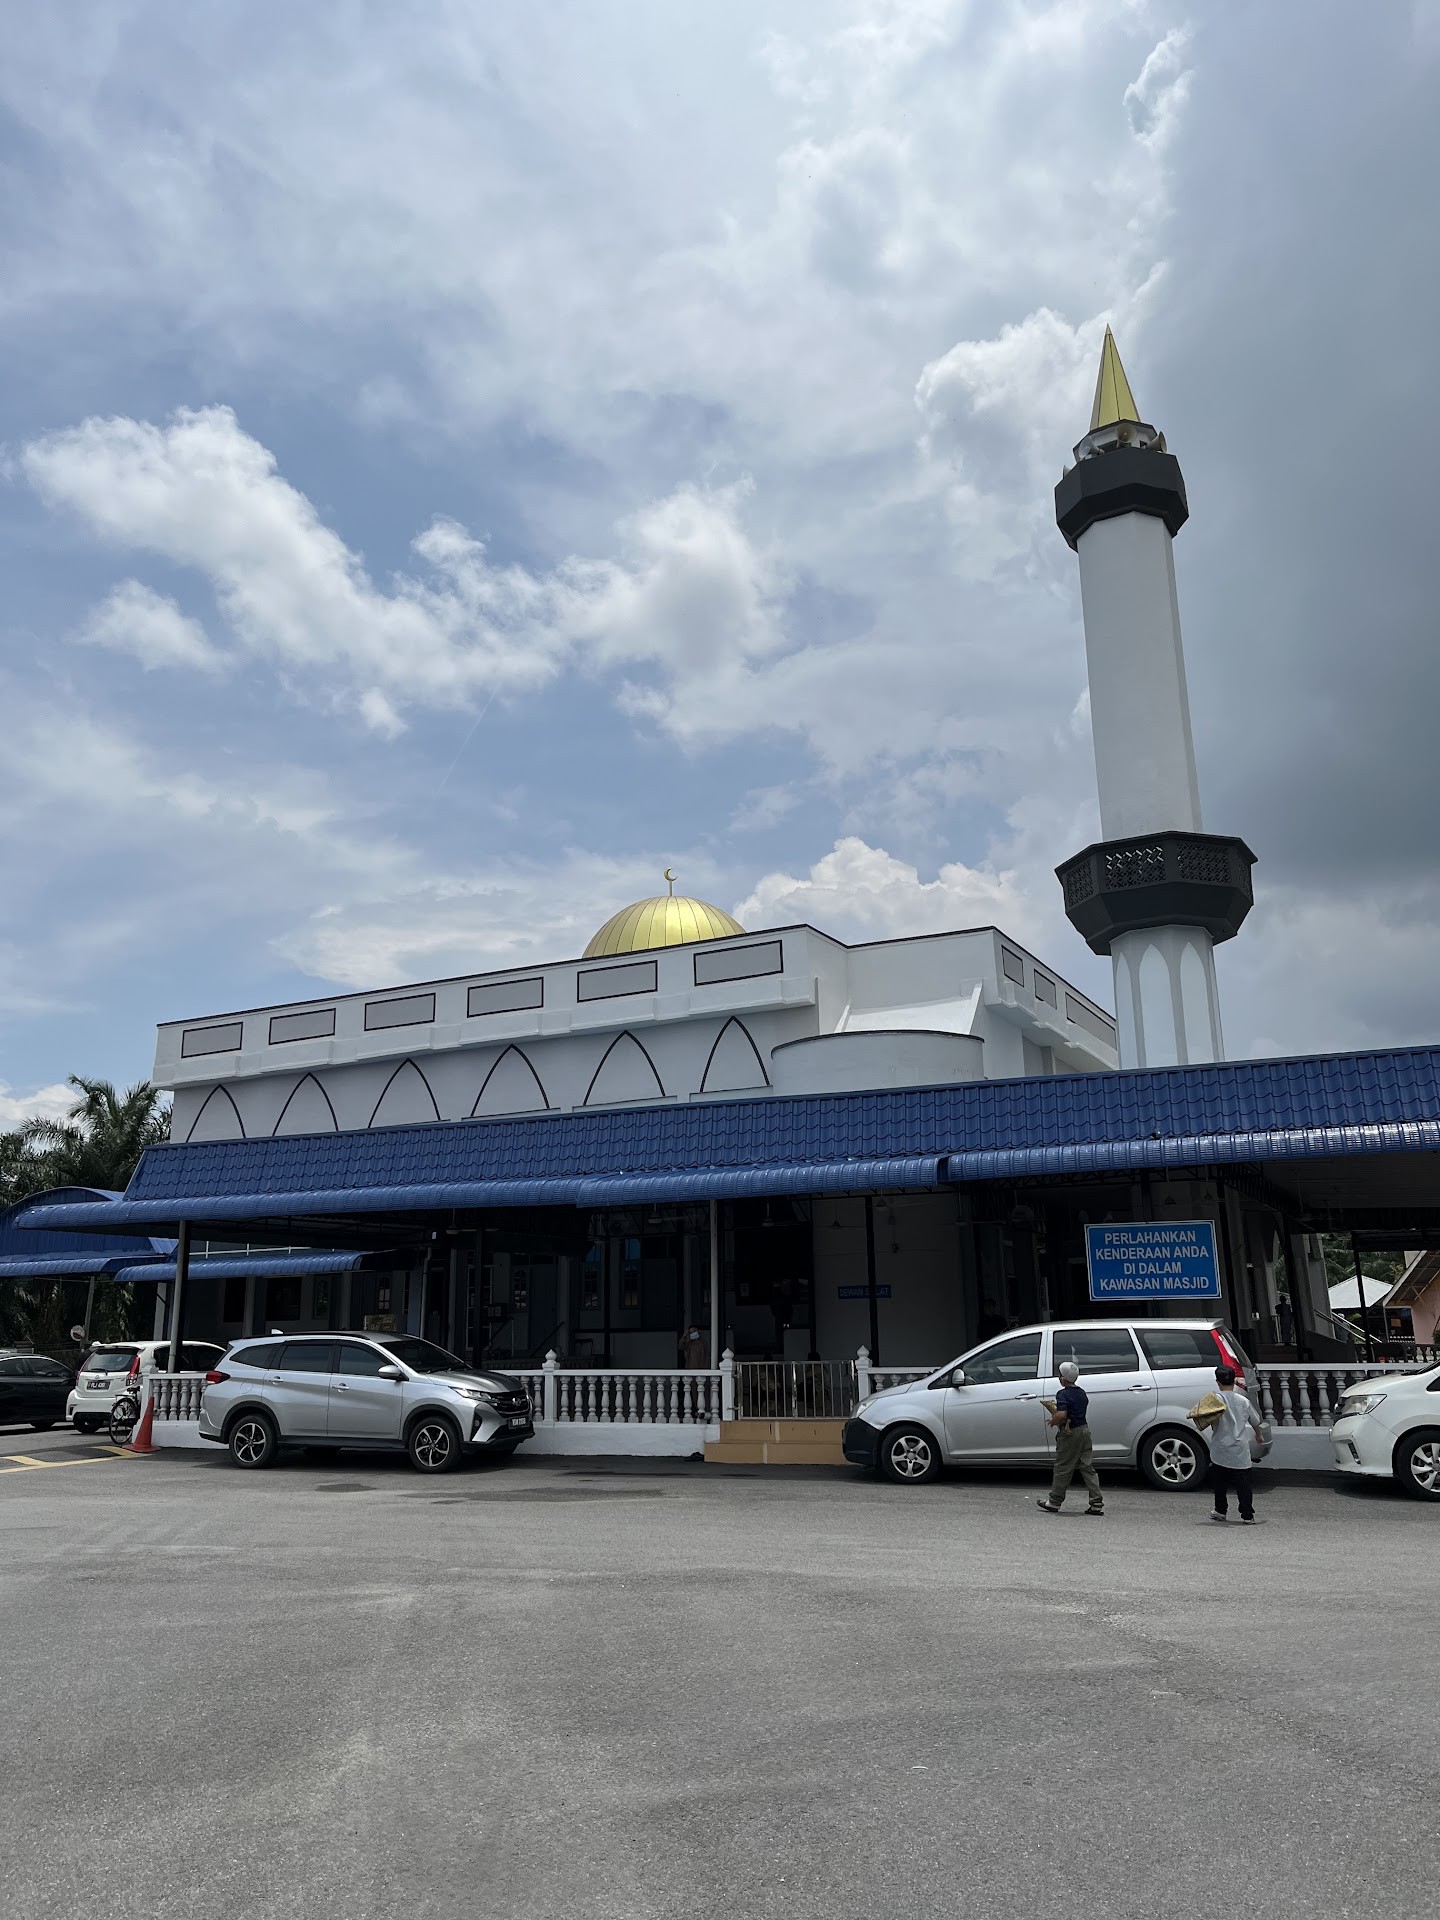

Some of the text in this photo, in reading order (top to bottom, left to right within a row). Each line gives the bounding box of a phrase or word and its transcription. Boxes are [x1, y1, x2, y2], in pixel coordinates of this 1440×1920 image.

[1104, 1230, 1196, 1245] PERLAHANKAN
[1095, 1245, 1209, 1260] KENDERAAN ANDA
[1123, 1261, 1182, 1275] DI DALAM
[1100, 1276, 1210, 1291] KAWASAN MASJID
